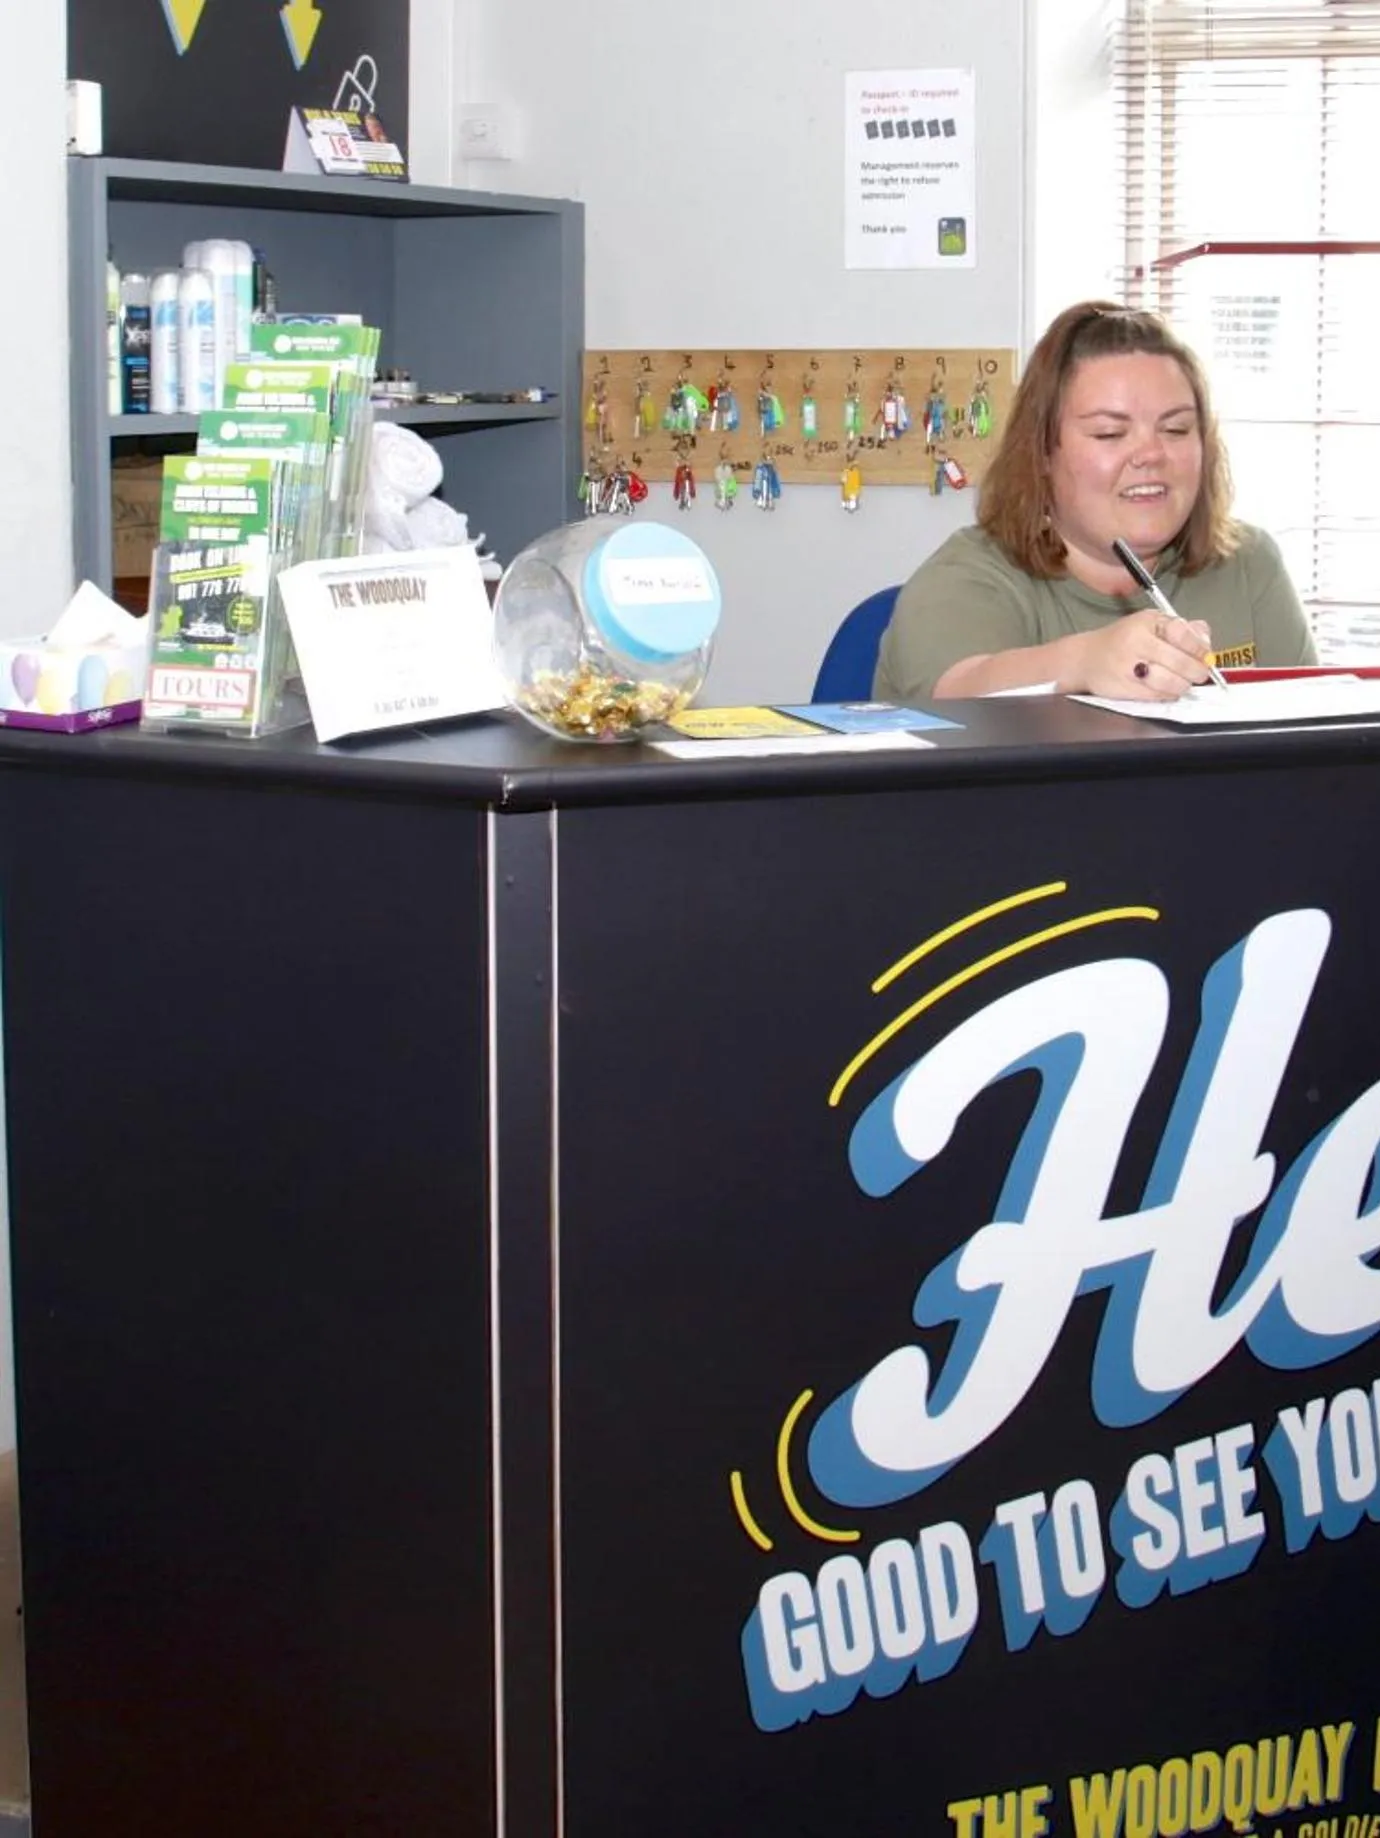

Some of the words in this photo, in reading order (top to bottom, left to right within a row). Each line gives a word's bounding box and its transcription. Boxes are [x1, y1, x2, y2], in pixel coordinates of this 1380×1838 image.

[861, 161, 919, 172] Management
[682, 354, 693, 369] 3
[765, 354, 775, 369] 5
[810, 357, 820, 370] 6
[936, 356, 946, 375] 9
[978, 358, 998, 377] 10
[328, 582, 357, 609] THE
[356, 576, 427, 606] WOODQUAY
[161, 675, 245, 699] TOURS
[756, 1519, 980, 1695] GOOD
[994, 1478, 1107, 1616] TO
[1125, 1423, 1266, 1573] SEE
[1069, 1721, 1356, 1838] WOODQUAY
